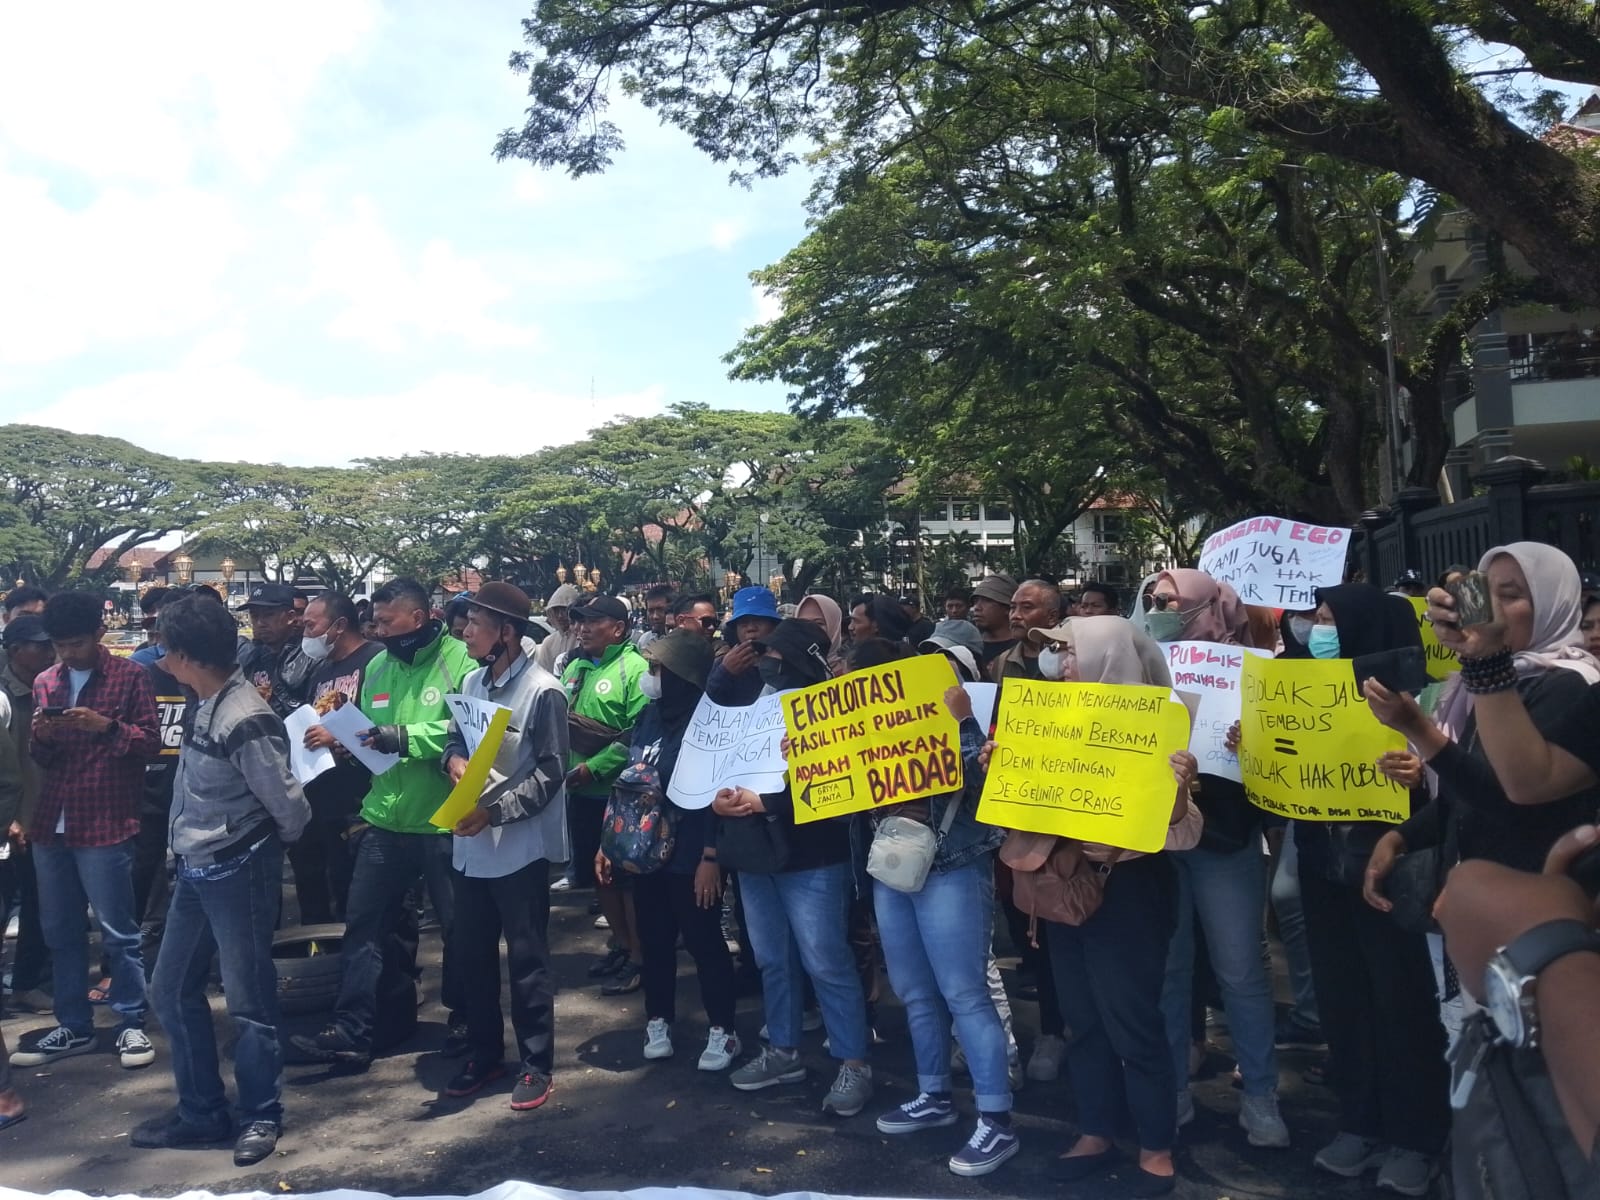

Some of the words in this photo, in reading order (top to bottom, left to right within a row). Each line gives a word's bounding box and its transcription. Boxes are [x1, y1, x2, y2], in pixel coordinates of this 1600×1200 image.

[1203, 518, 1281, 557] JANGAN
[1289, 522, 1343, 544] EGO
[1204, 548, 1239, 575] KAMI
[1243, 541, 1301, 565] JUGA
[1278, 568, 1322, 582] HAK
[1240, 584, 1262, 601] AR
[1274, 584, 1318, 605] TEMB
[1169, 645, 1241, 668] PUBLIK
[790, 670, 905, 731] EKSPLOITASI
[1009, 685, 1071, 708] JANGAN
[1077, 690, 1165, 714] MENGHAMBAT
[1321, 681, 1366, 708] JAL
[790, 721, 865, 758] FASILITAS
[873, 702, 938, 731] PUBLIK
[1005, 711, 1083, 739] KEPENTINGAN
[1089, 722, 1158, 747] BERSAMA
[1256, 709, 1332, 732] TEMBUS
[795, 755, 851, 783] ADALAH
[857, 733, 948, 766] TINDAKAN
[1001, 748, 1034, 768] DEMI
[1040, 757, 1116, 778] KEPENTINGAN
[866, 748, 958, 804] BIADAB
[1300, 764, 1335, 790] HAK
[993, 775, 1065, 803] SE-GELINTIR
[1070, 788, 1122, 811] ORANG
